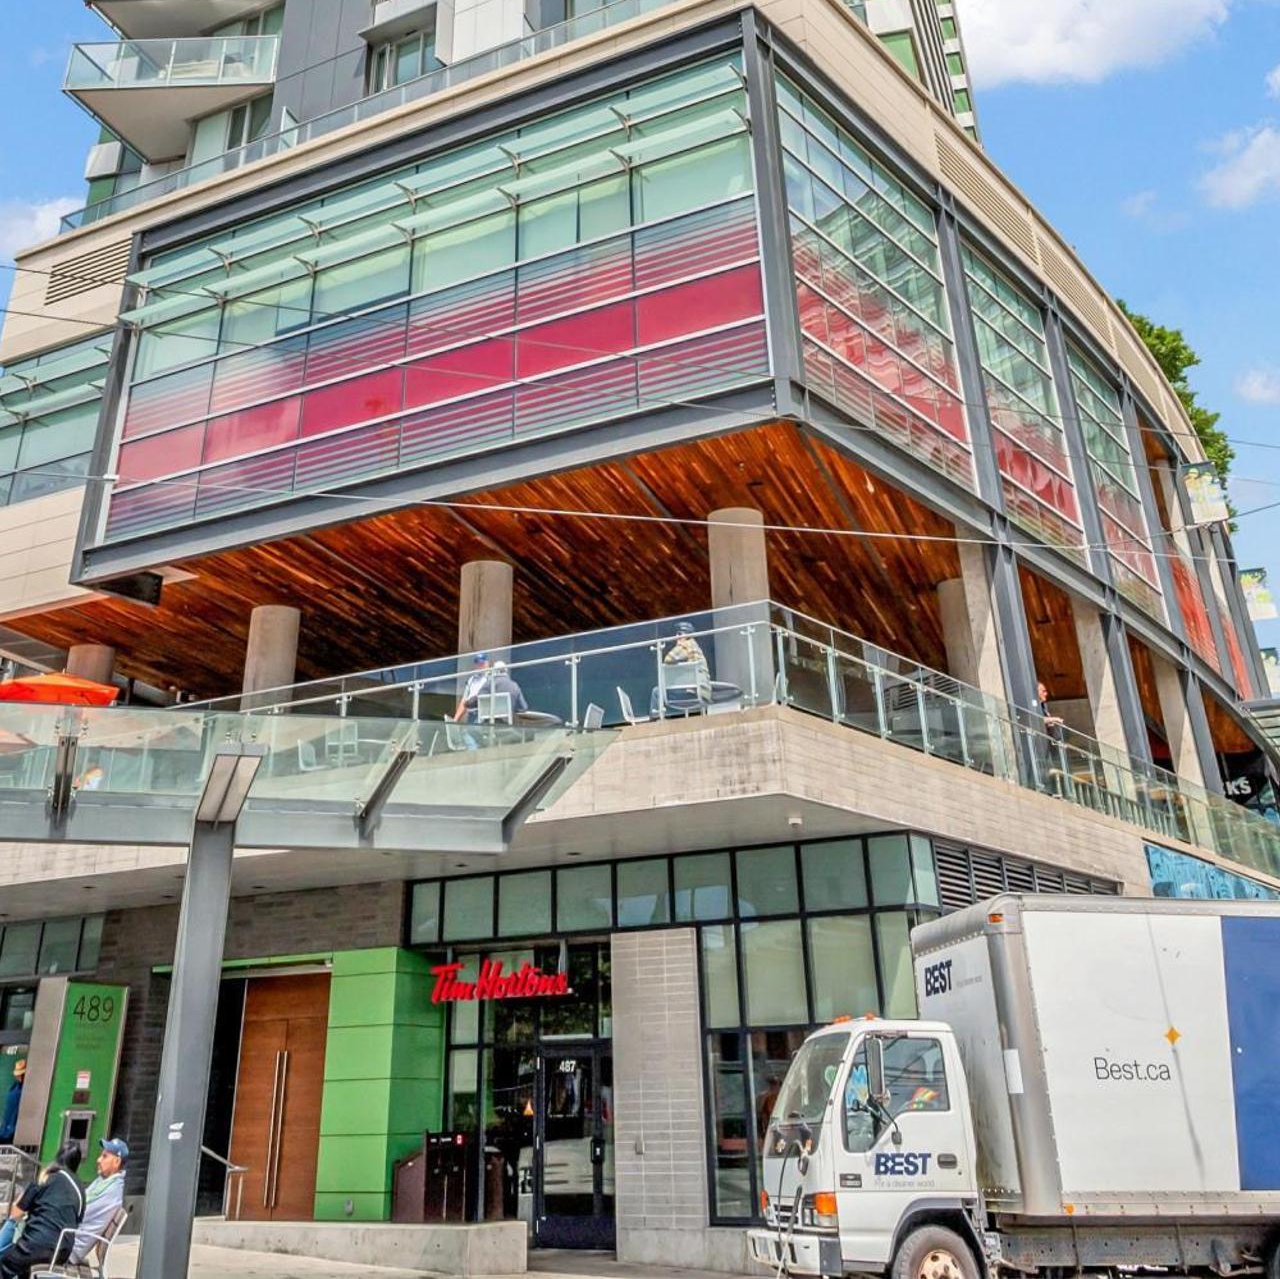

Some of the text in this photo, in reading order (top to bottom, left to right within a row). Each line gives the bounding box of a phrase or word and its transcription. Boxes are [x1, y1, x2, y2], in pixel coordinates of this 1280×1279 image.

[1225, 776, 1252, 795] KS
[430, 957, 568, 1004] Tim Hortons
[924, 959, 952, 997] BEST
[73, 995, 114, 1022] 489
[559, 1060, 576, 1072] 487
[1094, 1057, 1171, 1080] Best.ca
[874, 1153, 932, 1176] BEST
